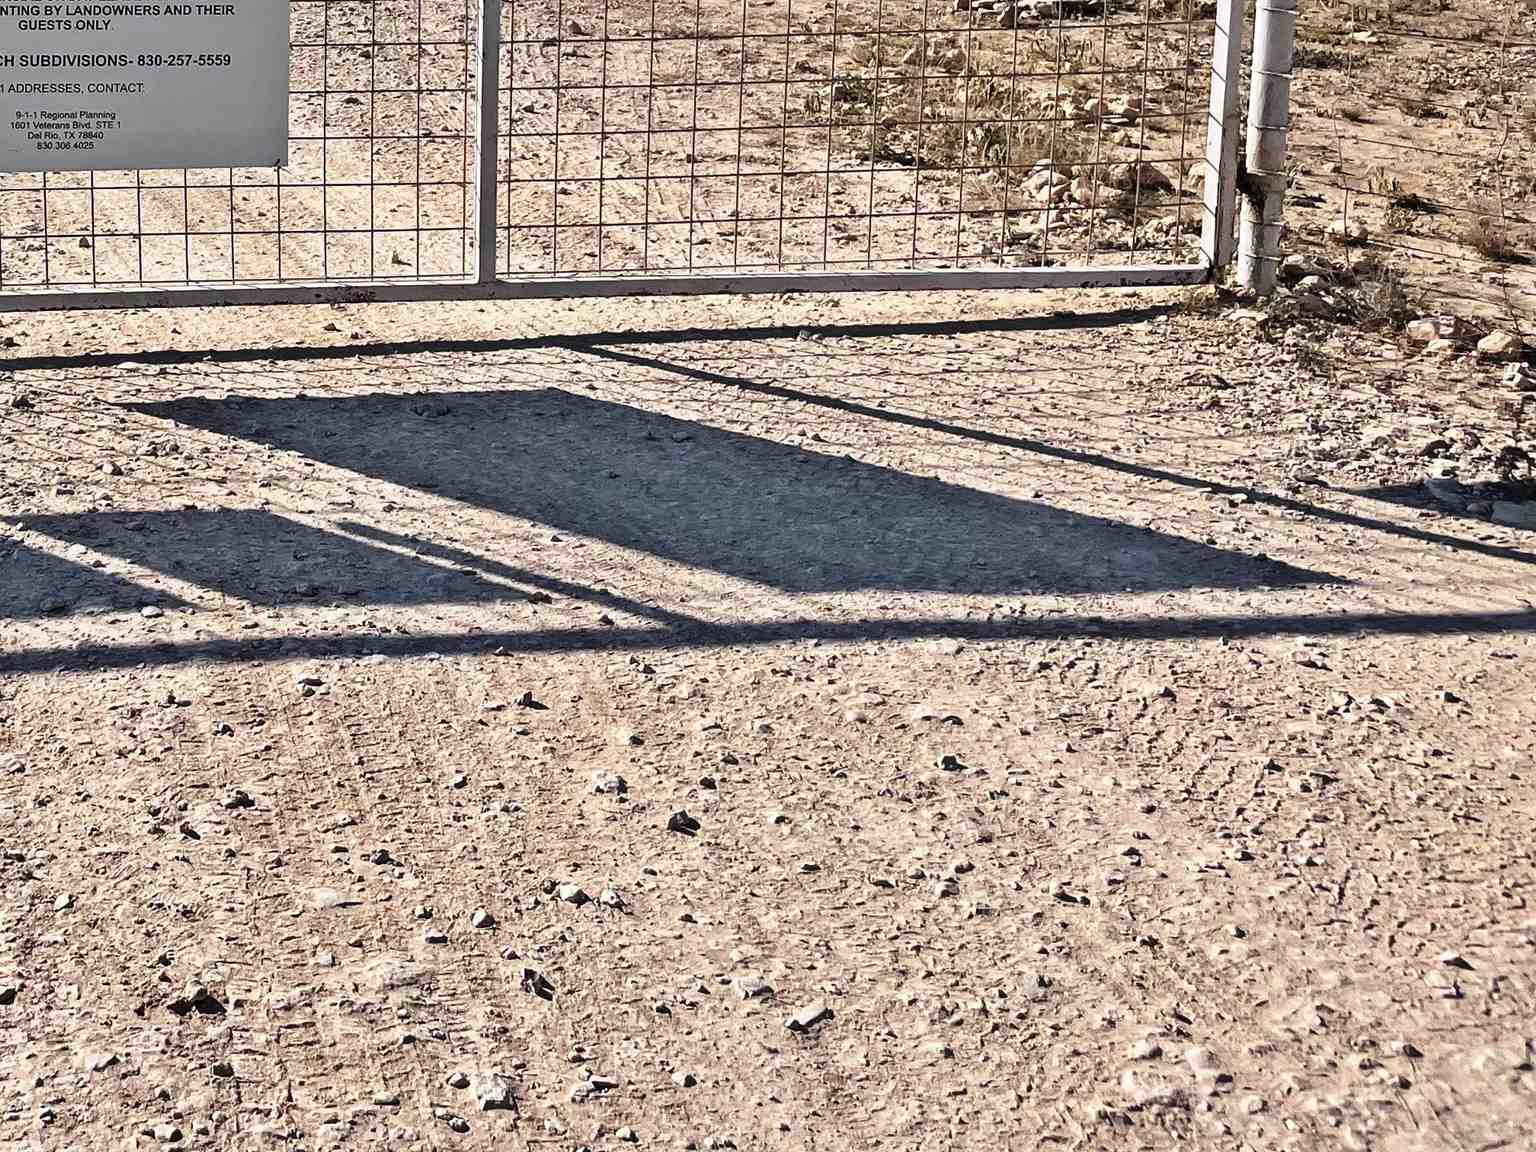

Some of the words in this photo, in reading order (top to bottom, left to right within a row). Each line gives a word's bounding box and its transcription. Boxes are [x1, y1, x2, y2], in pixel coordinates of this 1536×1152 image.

[44, 5, 63, 16] BY
[66, 5, 161, 16] LANDOWNERS
[164, 5, 192, 16] AND
[195, 5, 235, 16] THEIR
[18, 20, 72, 31] GUESTS
[19, 54, 134, 67] SUBDIVISIONS-
[137, 54, 231, 67] 830-257-5559
[7, 83, 84, 94] ADDRESSES,
[15, 111, 38, 119] 9-1-1
[40, 111, 78, 121] Regional
[79, 110, 116, 120] Planning
[11, 121, 31, 129] 1601
[32, 121, 70, 129] Veterans
[95, 121, 113, 129] STE
[27, 131, 42, 139] Del
[64, 131, 76, 139] TX
[78, 131, 104, 139] 78840
[73, 141, 95, 150] 4025
